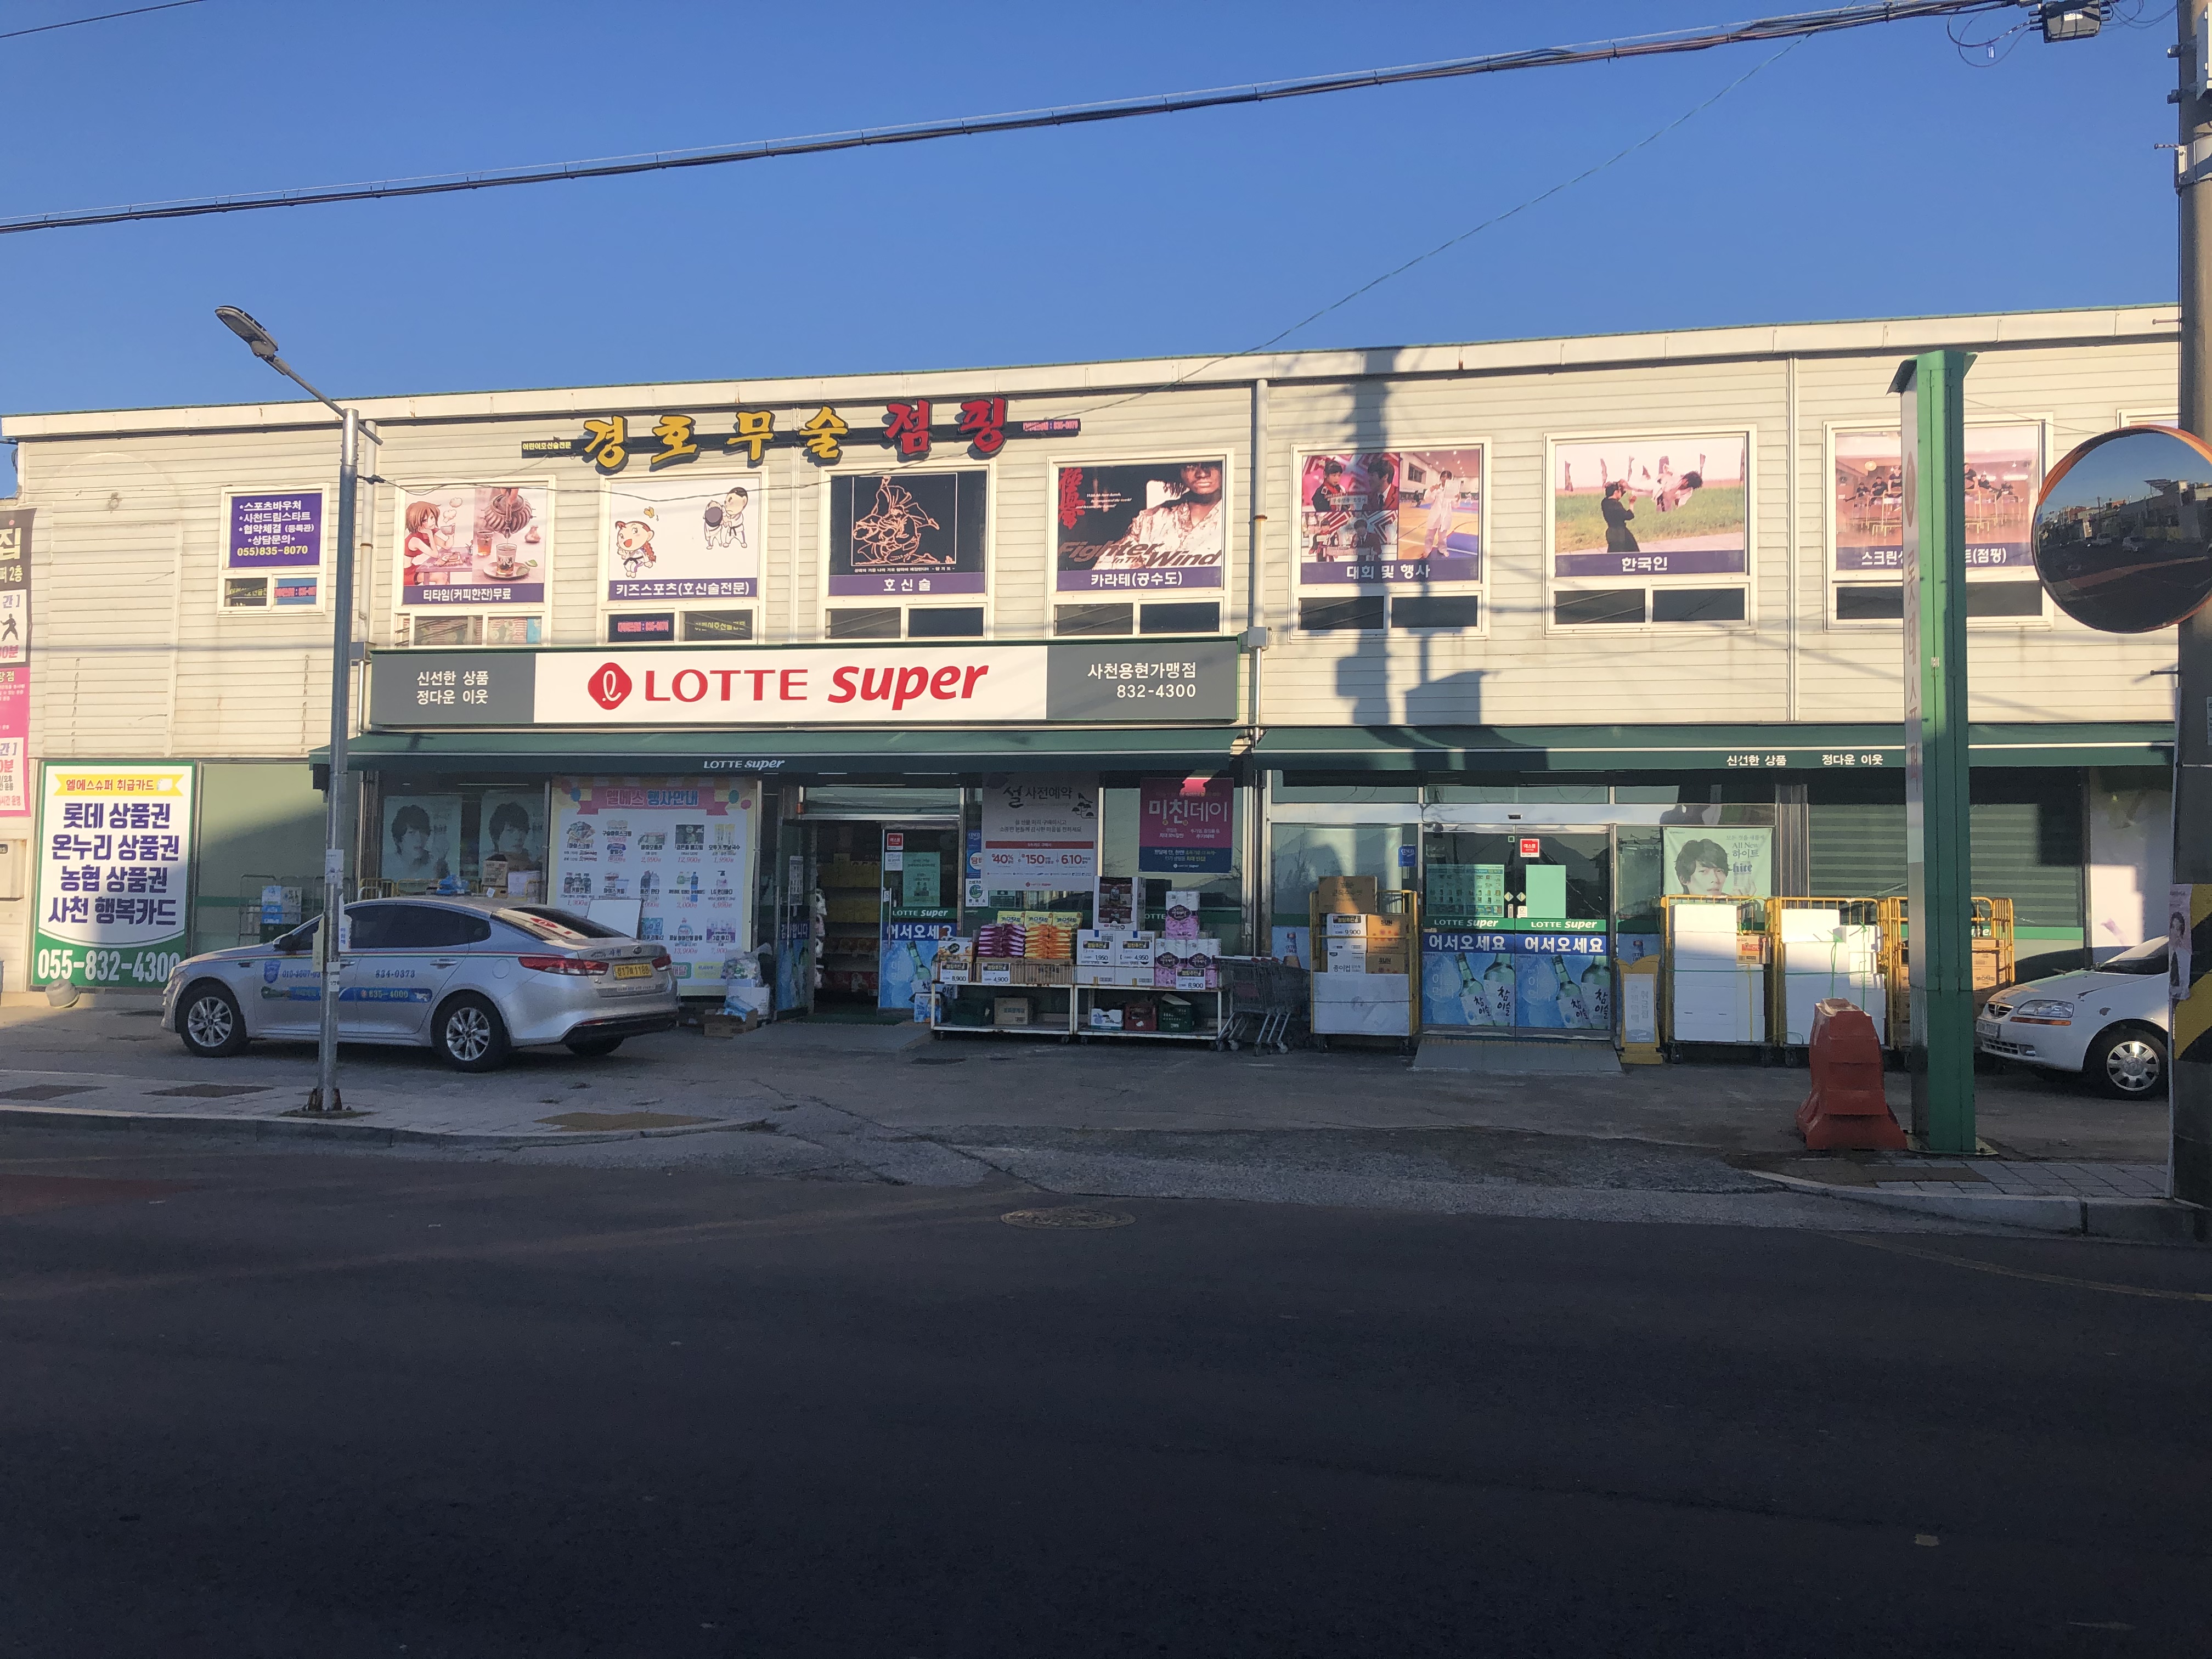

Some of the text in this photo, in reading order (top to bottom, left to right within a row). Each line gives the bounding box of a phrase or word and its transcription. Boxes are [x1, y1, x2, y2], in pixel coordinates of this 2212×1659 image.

[243, 500, 302, 512] 스포츠바우처
[243, 511, 311, 523] 사천드림스타트
[243, 523, 281, 534] 협약체결
[252, 534, 291, 545] 상담문의
[237, 545, 308, 556] 055)835-8070
[1058, 540, 1164, 562] Fighter
[1144, 550, 1222, 567] Wind
[1346, 564, 1431, 580] 대회 및 행사
[1621, 556, 1668, 572] 한국인
[1091, 571, 1182, 588] 카라테(공수도)
[423, 588, 511, 602] 티타임(커피한잔)무료
[616, 582, 749, 597] 키즈스포츠(호신술전문)
[416, 670, 489, 686] 신선한 상품
[1087, 661, 1197, 680] 사천용현가맹점
[645, 664, 989, 711] LOTTE super
[1116, 683, 1197, 699] 832-4300
[416, 689, 489, 705] 정다운 이웃
[703, 759, 785, 771] LOTTE super
[1726, 754, 1787, 766] 신선한 상품
[1821, 754, 1883, 766] 정다운 이웃
[66, 779, 154, 791] 엘에스슈퍼 취급카드
[1024, 786, 1073, 800] 사전예약
[647, 789, 699, 806] 행사안내
[63, 802, 171, 830] 롯데 상품권
[1149, 799, 1228, 824] 미친데이
[52, 834, 179, 861] 온누리 상품권
[1733, 850, 1760, 859] 하이트
[1733, 862, 1753, 873] hite
[61, 864, 168, 894] 농협 상품권
[48, 896, 177, 926] 사천 행복카드
[921, 910, 949, 918] super
[1467, 915, 1499, 928] super
[1565, 921, 1598, 929] super
[1429, 934, 1506, 952] 어서오세요
[1525, 936, 1604, 953] 어서오세요
